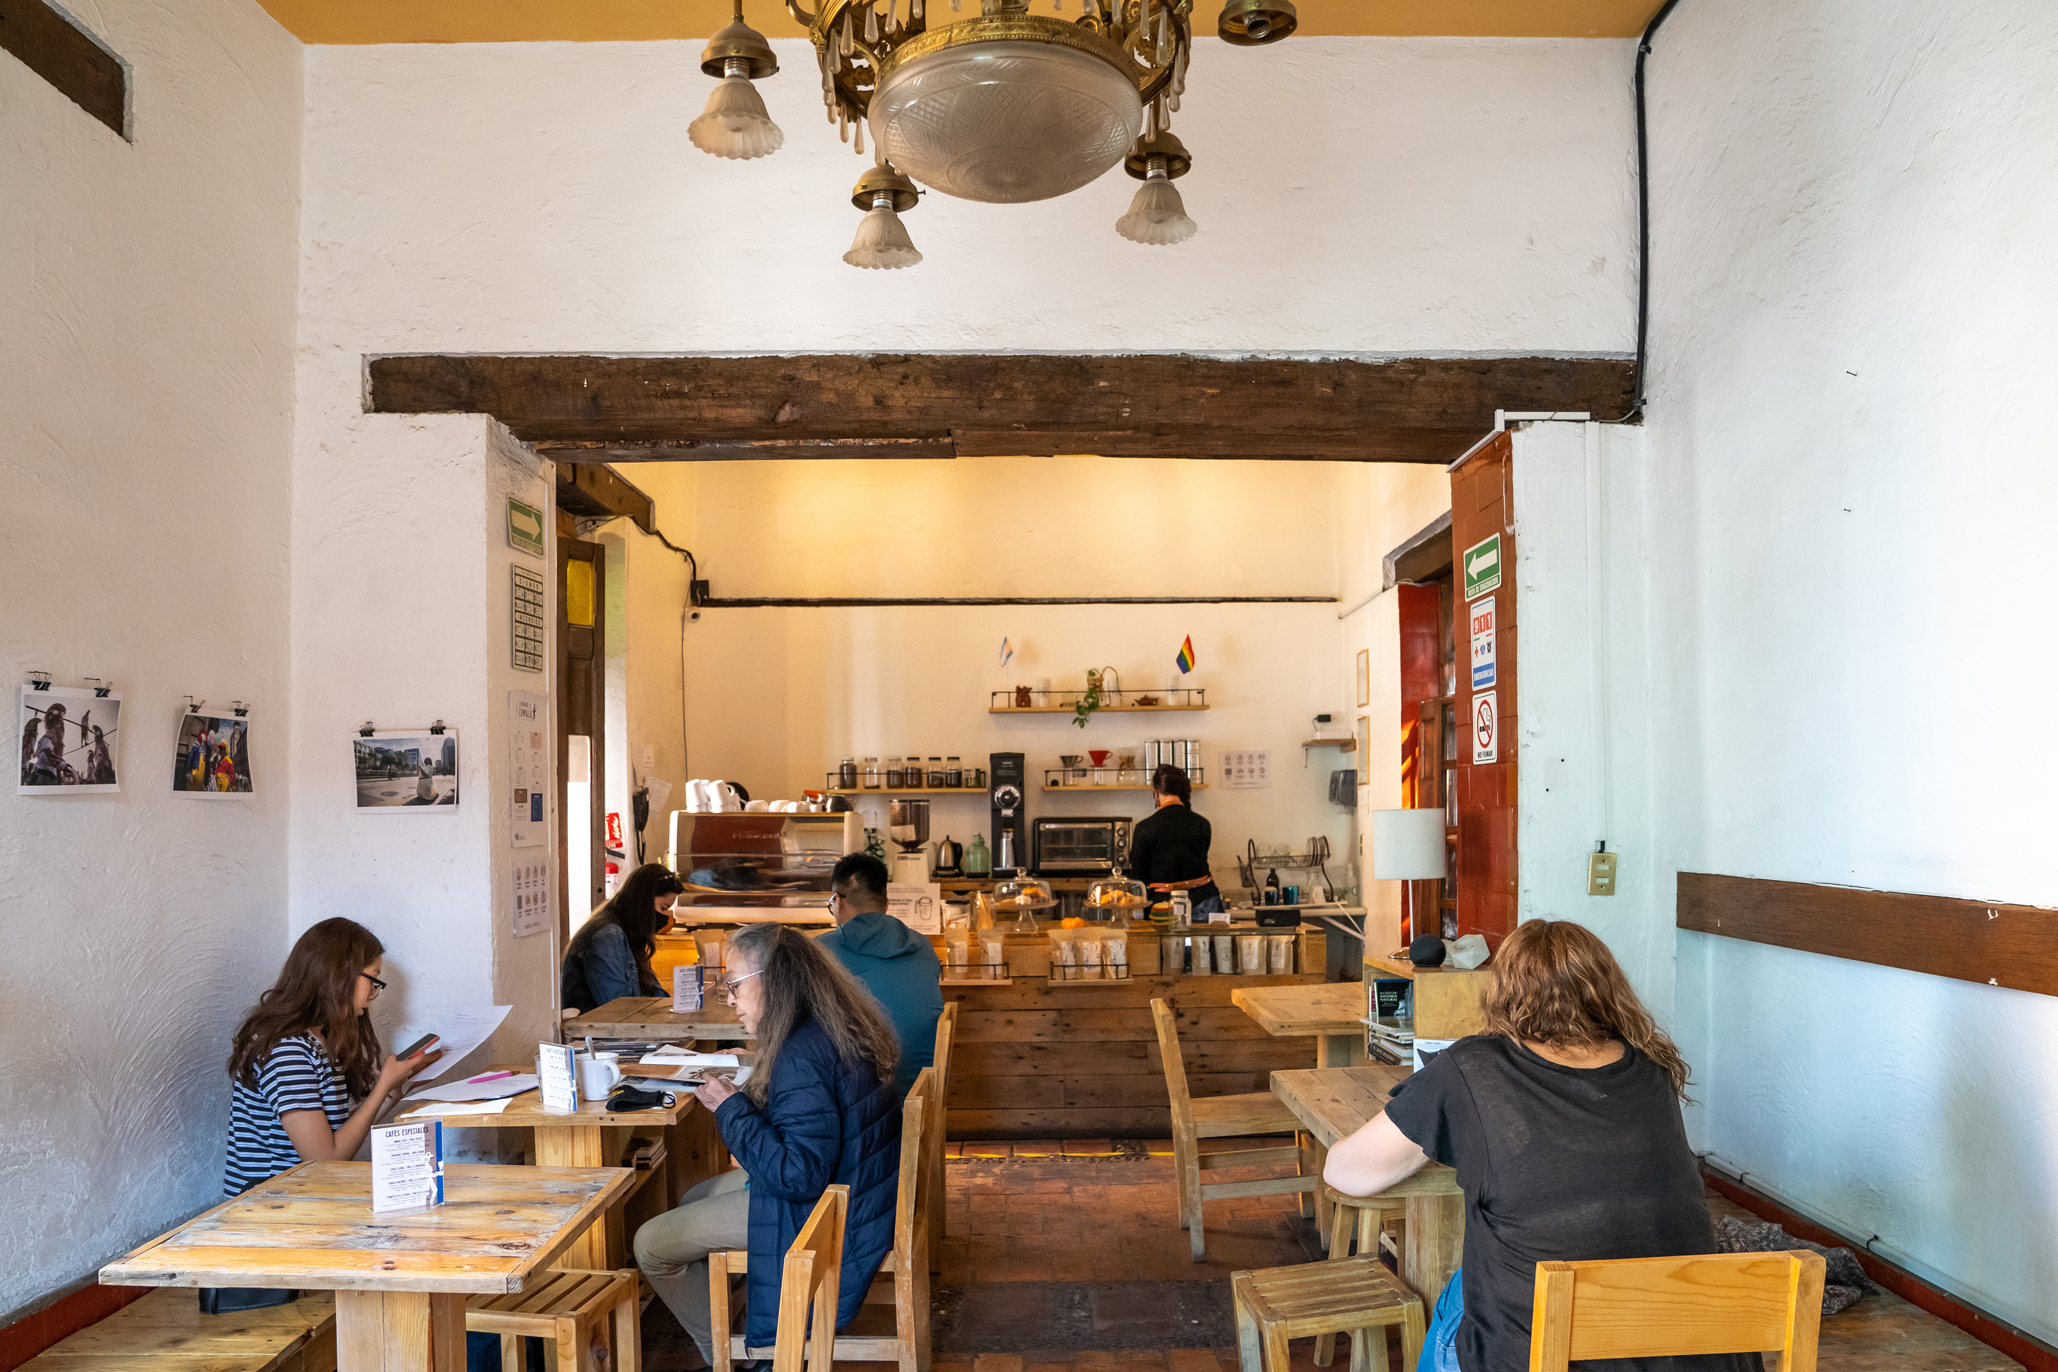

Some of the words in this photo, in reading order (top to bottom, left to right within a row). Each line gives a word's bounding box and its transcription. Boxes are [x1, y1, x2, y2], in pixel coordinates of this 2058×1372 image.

[519, 577, 539, 590] SISMOS
[517, 614, 541, 626] INCENDIOS
[1474, 613, 1491, 633] 911
[1473, 667, 1494, 681] EMERGENCIAS
[1482, 750, 1493, 758] FUMAR
[385, 1129, 401, 1138] CAFES
[401, 1126, 429, 1136] ESPECIALES
